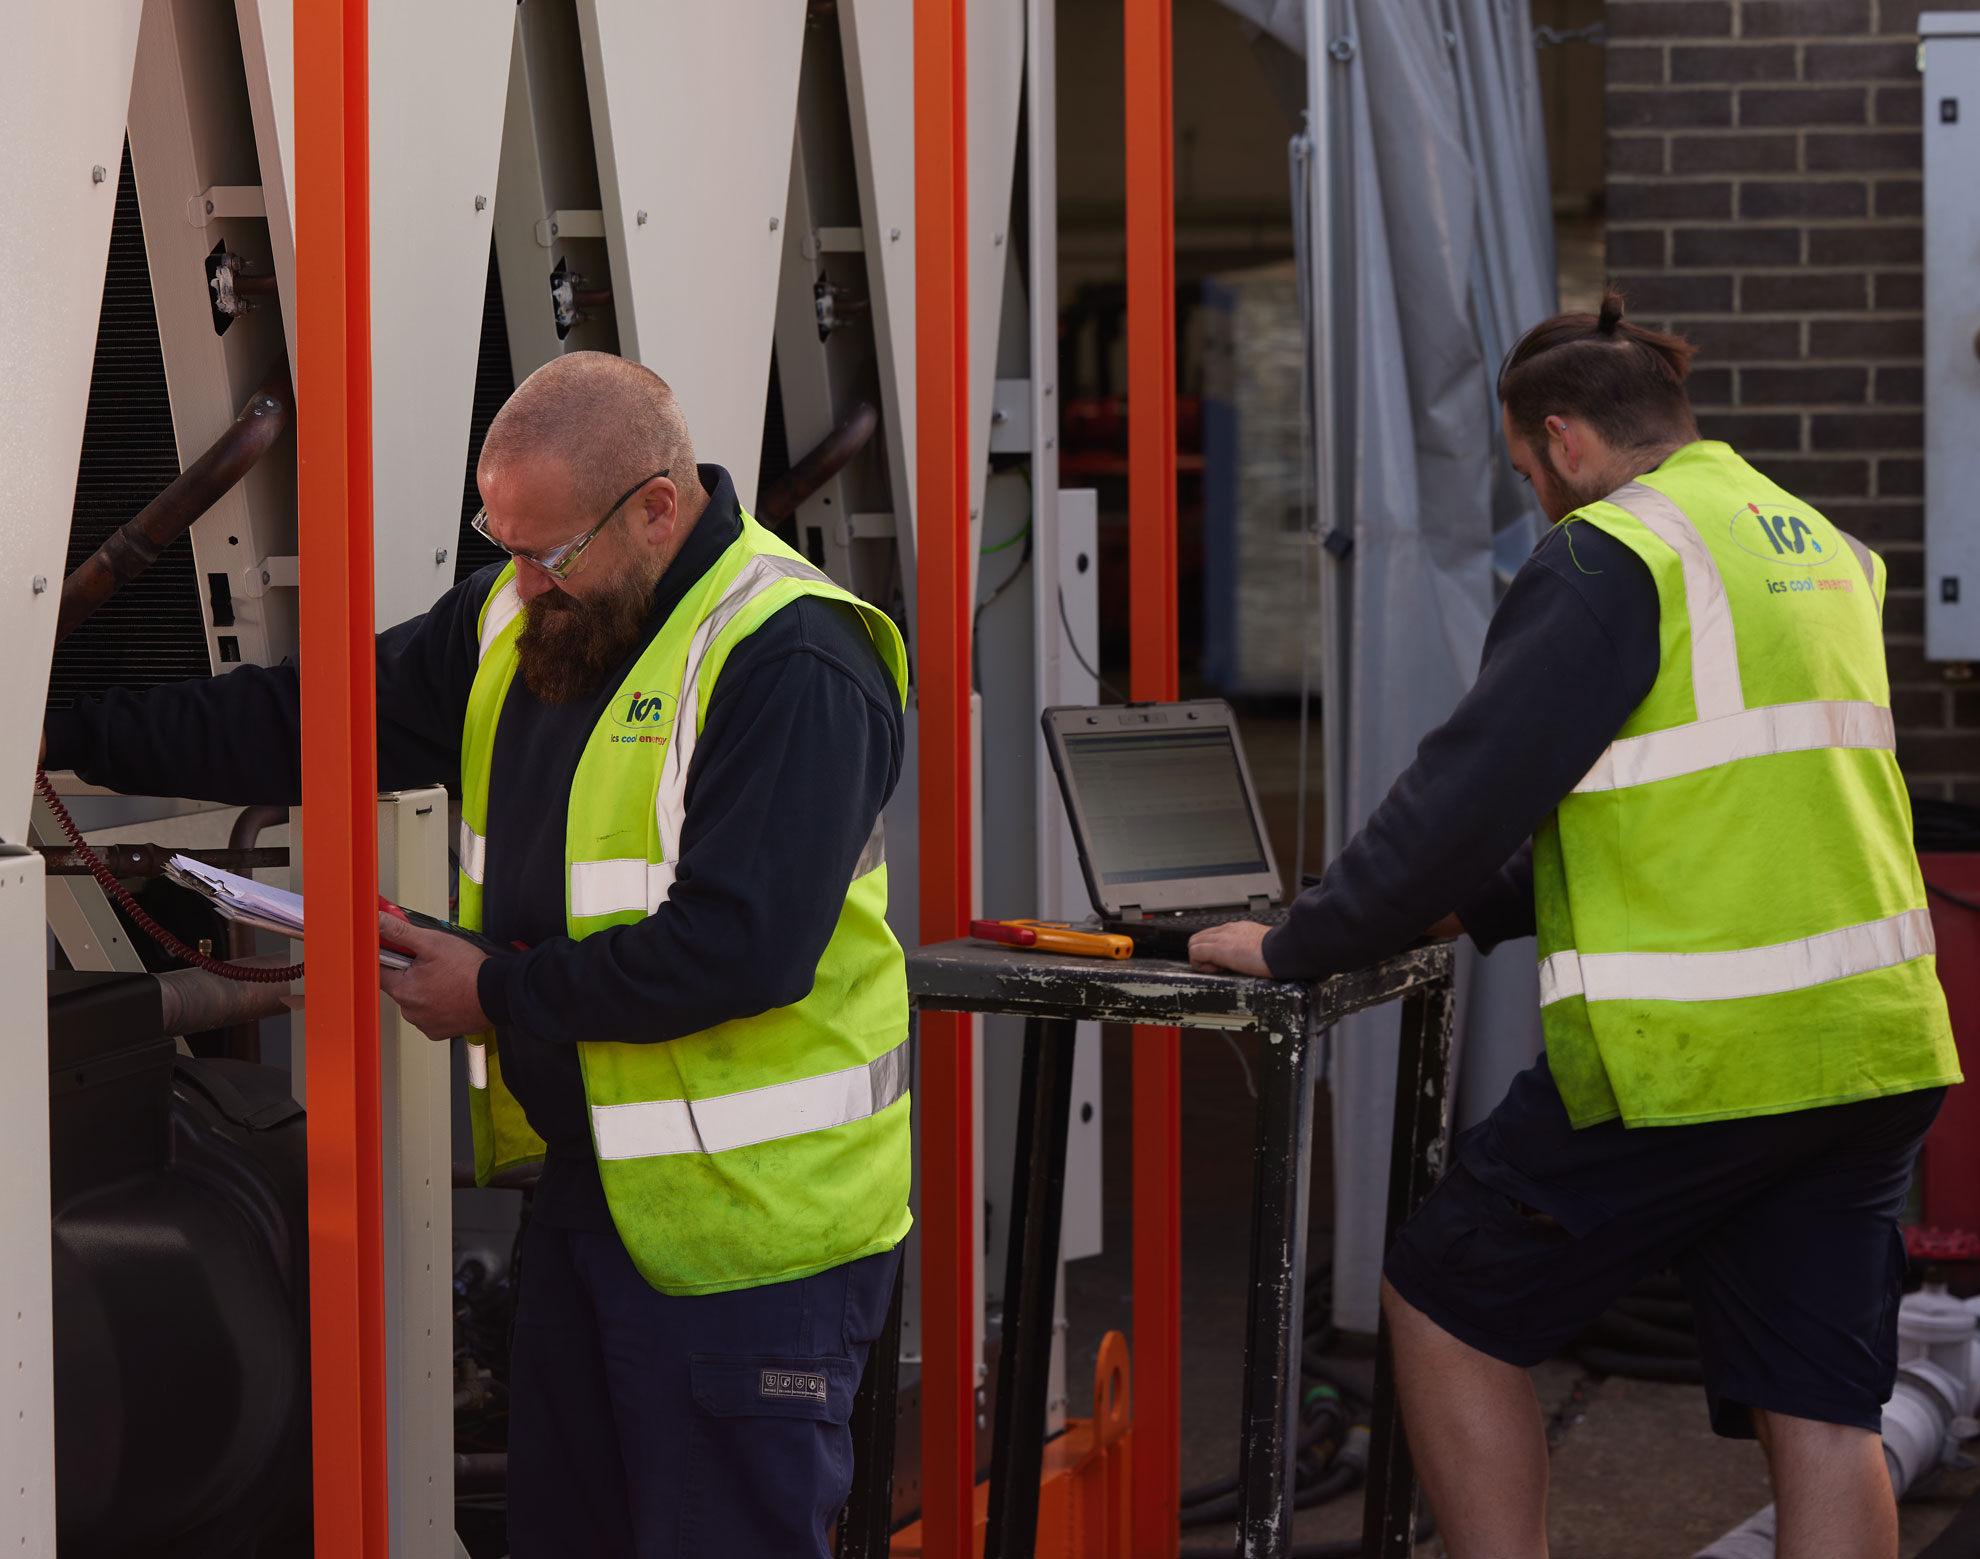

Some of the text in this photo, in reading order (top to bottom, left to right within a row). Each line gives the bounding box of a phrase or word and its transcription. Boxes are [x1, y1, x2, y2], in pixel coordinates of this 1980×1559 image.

[1765, 579, 1788, 594] ics
[1789, 576, 1815, 592] cool
[621, 734, 637, 742] cool
[639, 735, 667, 745] energy
